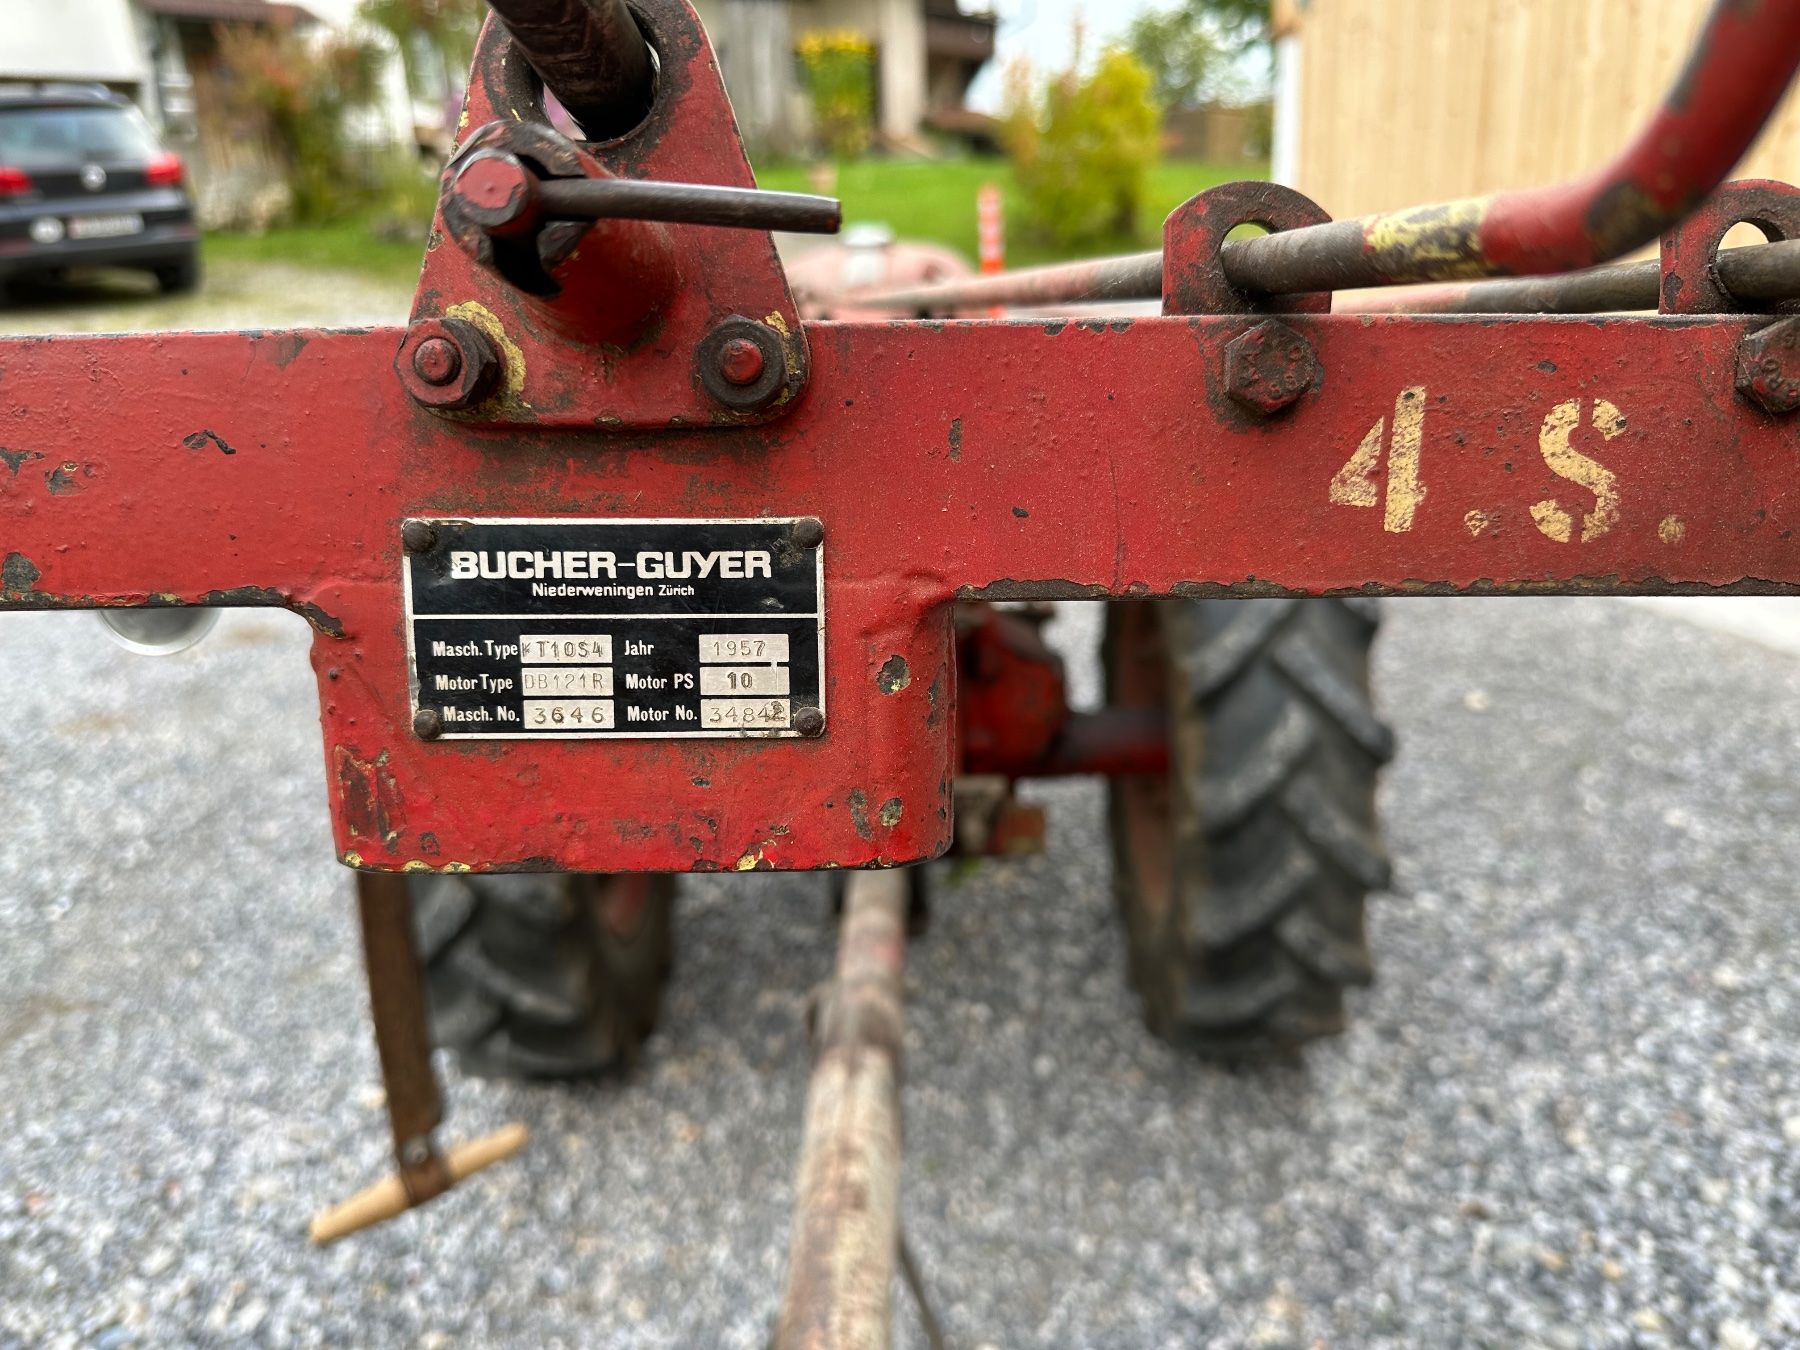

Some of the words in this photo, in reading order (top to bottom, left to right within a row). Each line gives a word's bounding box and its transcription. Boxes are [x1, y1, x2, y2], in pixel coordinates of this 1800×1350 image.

[450, 550, 772, 580] BUCHER-GUYER
[532, 582, 654, 600] Niederweningen
[658, 584, 695, 597] Zürich
[432, 640, 483, 657] Masch.
[485, 639, 518, 661] Type
[624, 639, 655, 656] Jahr
[713, 640, 766, 657] 1957
[435, 674, 478, 690] Motor
[479, 673, 514, 694] Type
[524, 673, 604, 690] DB121R
[625, 673, 668, 690] Motor
[673, 673, 695, 690] PS
[727, 671, 753, 690] 10
[443, 705, 494, 722] Masch.
[497, 706, 520, 722] No.
[534, 706, 605, 724] 3646
[627, 705, 670, 722] Motor
[675, 704, 698, 721] No.
